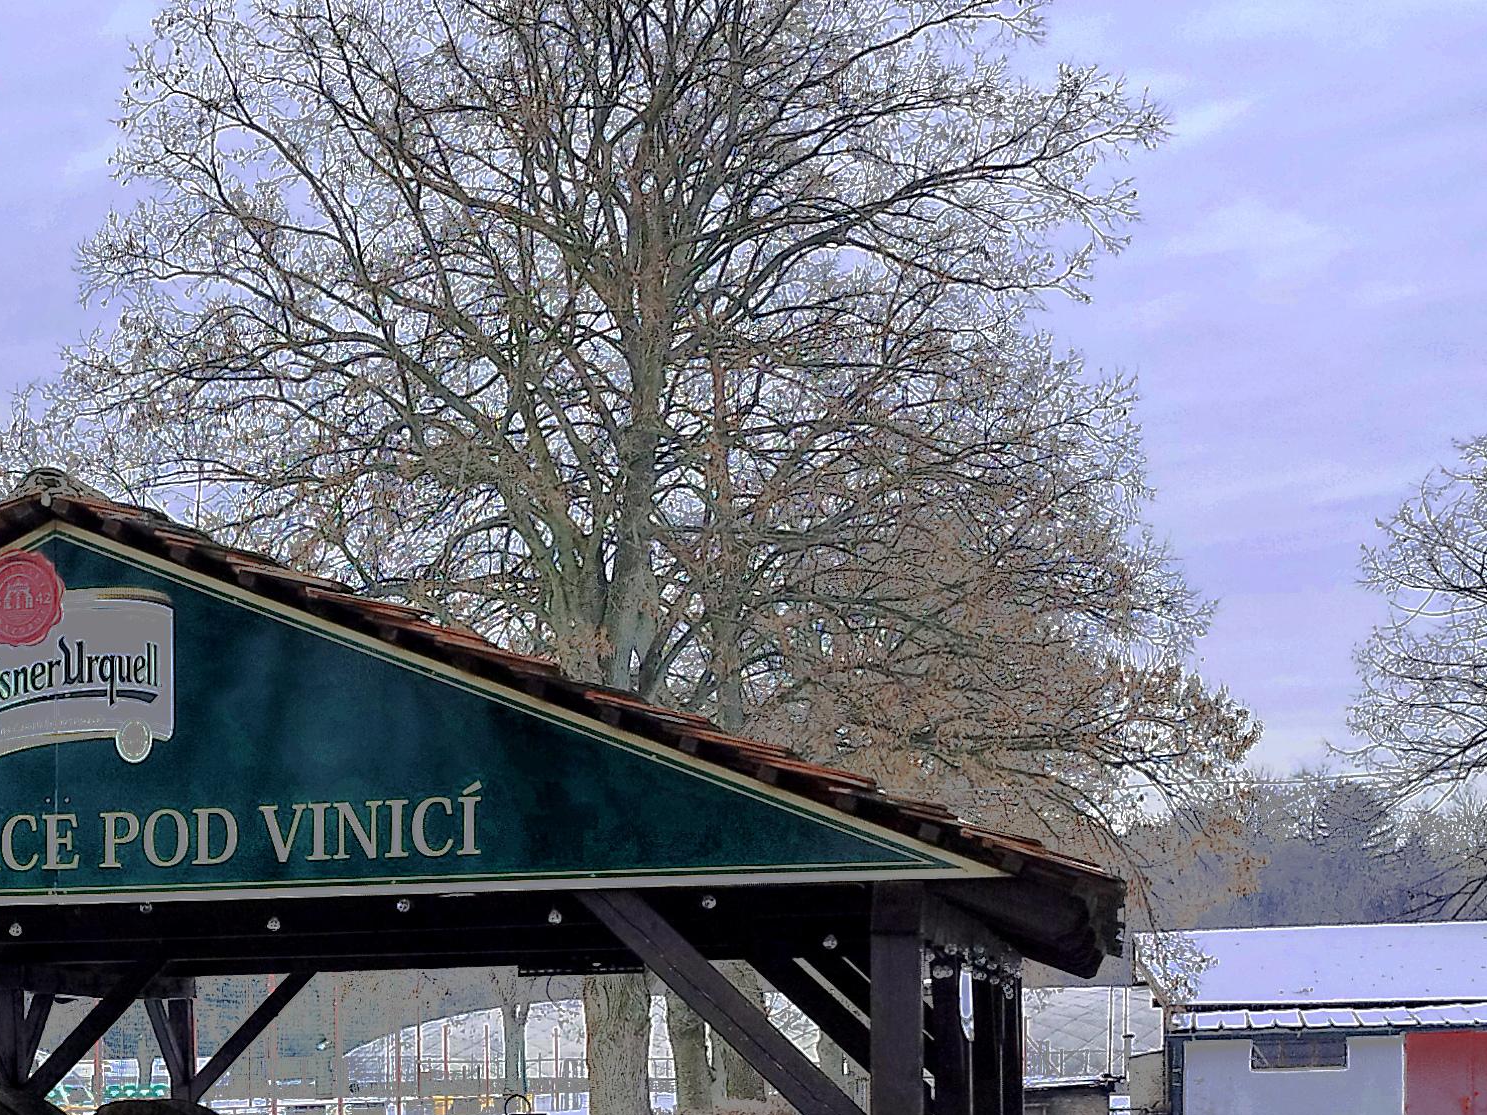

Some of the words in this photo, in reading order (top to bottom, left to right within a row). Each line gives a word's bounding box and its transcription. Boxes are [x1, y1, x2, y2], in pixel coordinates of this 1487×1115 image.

[58, 637, 158, 706] Urquell
[99, 807, 239, 868] POD
[258, 780, 483, 863] VINICÍ
